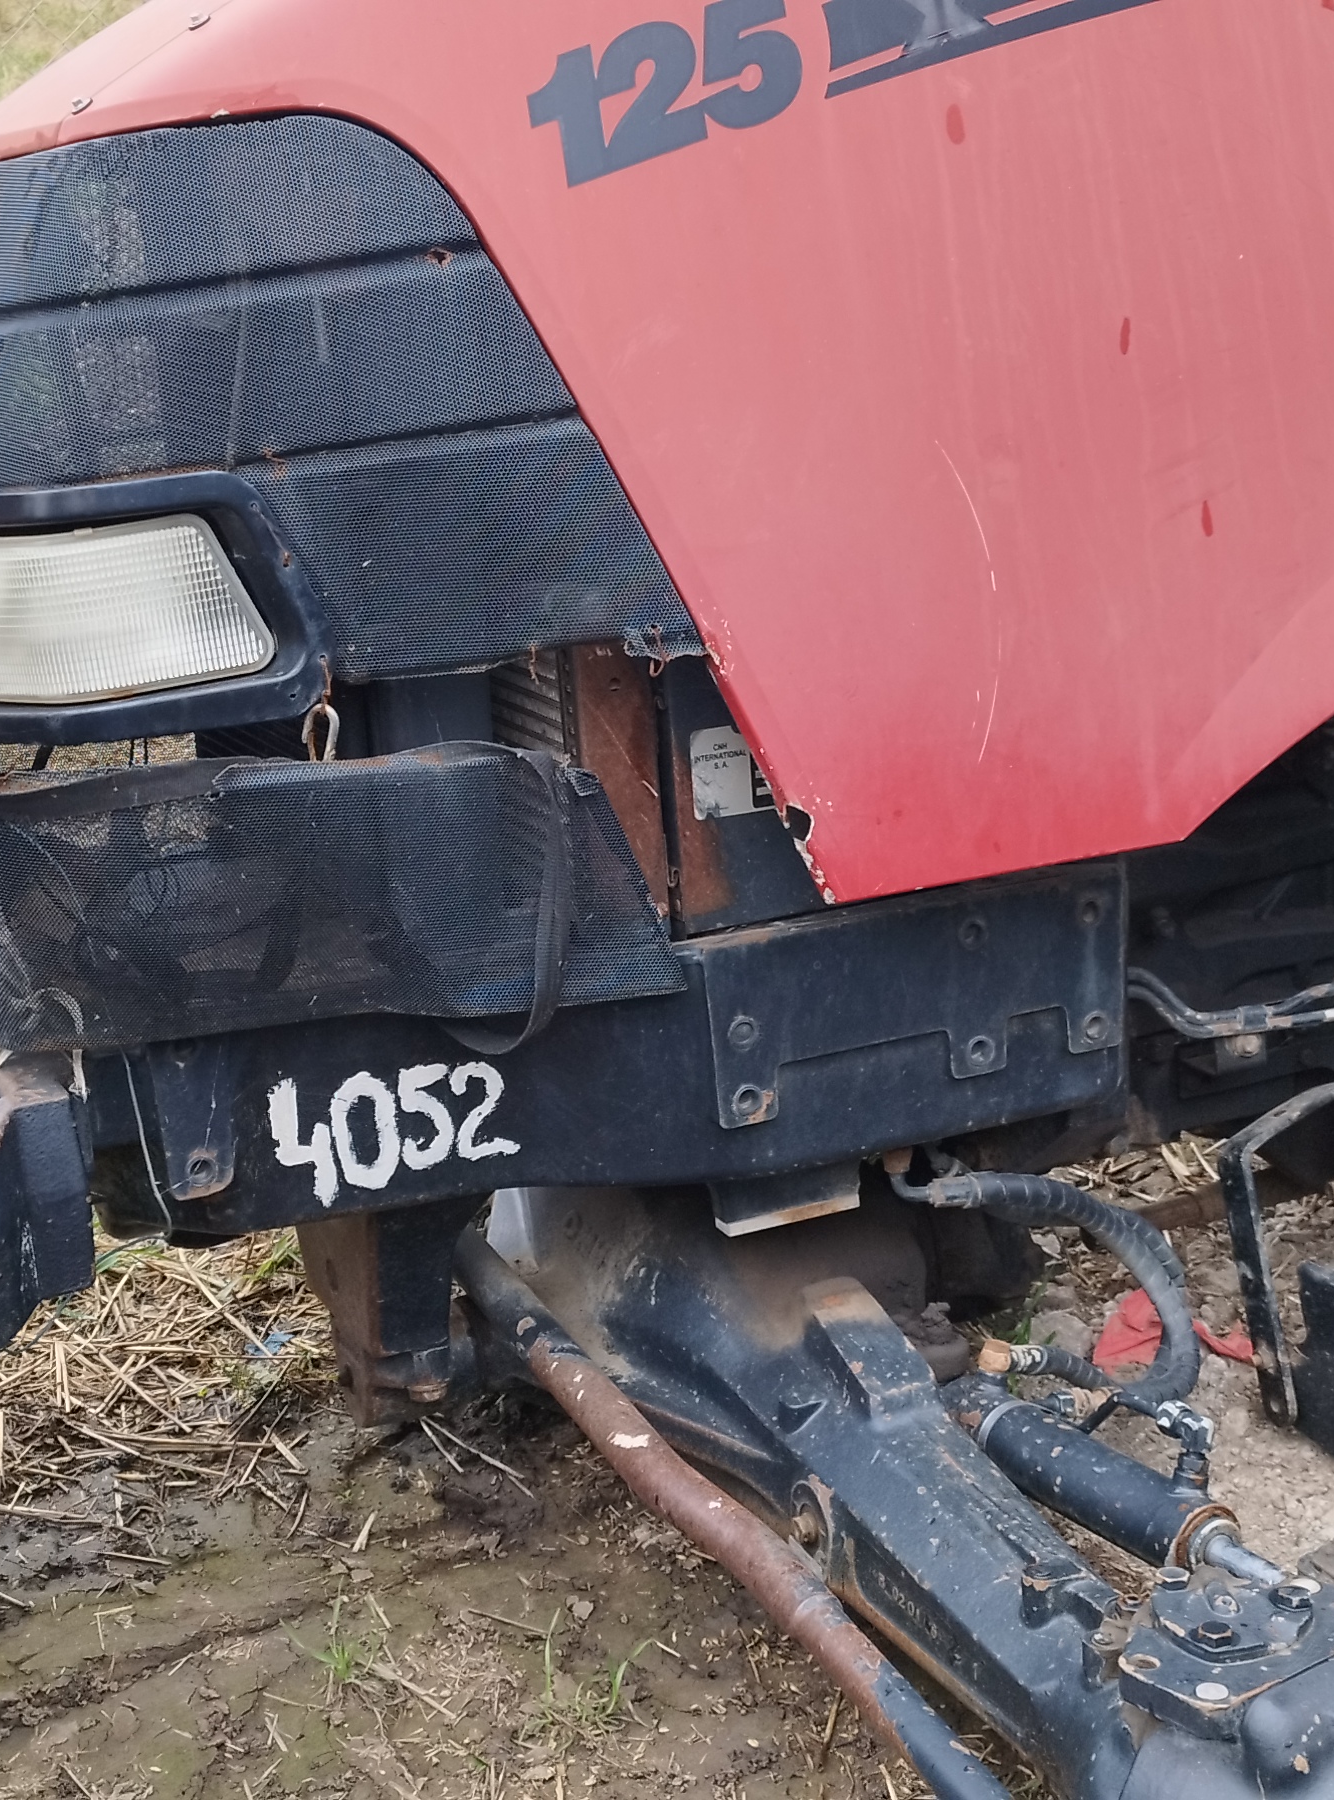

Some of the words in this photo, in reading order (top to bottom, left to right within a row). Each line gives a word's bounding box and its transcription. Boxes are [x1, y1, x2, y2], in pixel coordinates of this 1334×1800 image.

[527, 0, 802, 187] 125
[694, 750, 747, 764] INTERNATIONAL
[713, 743, 728, 751] CNH
[268, 1061, 522, 1208] 4052
